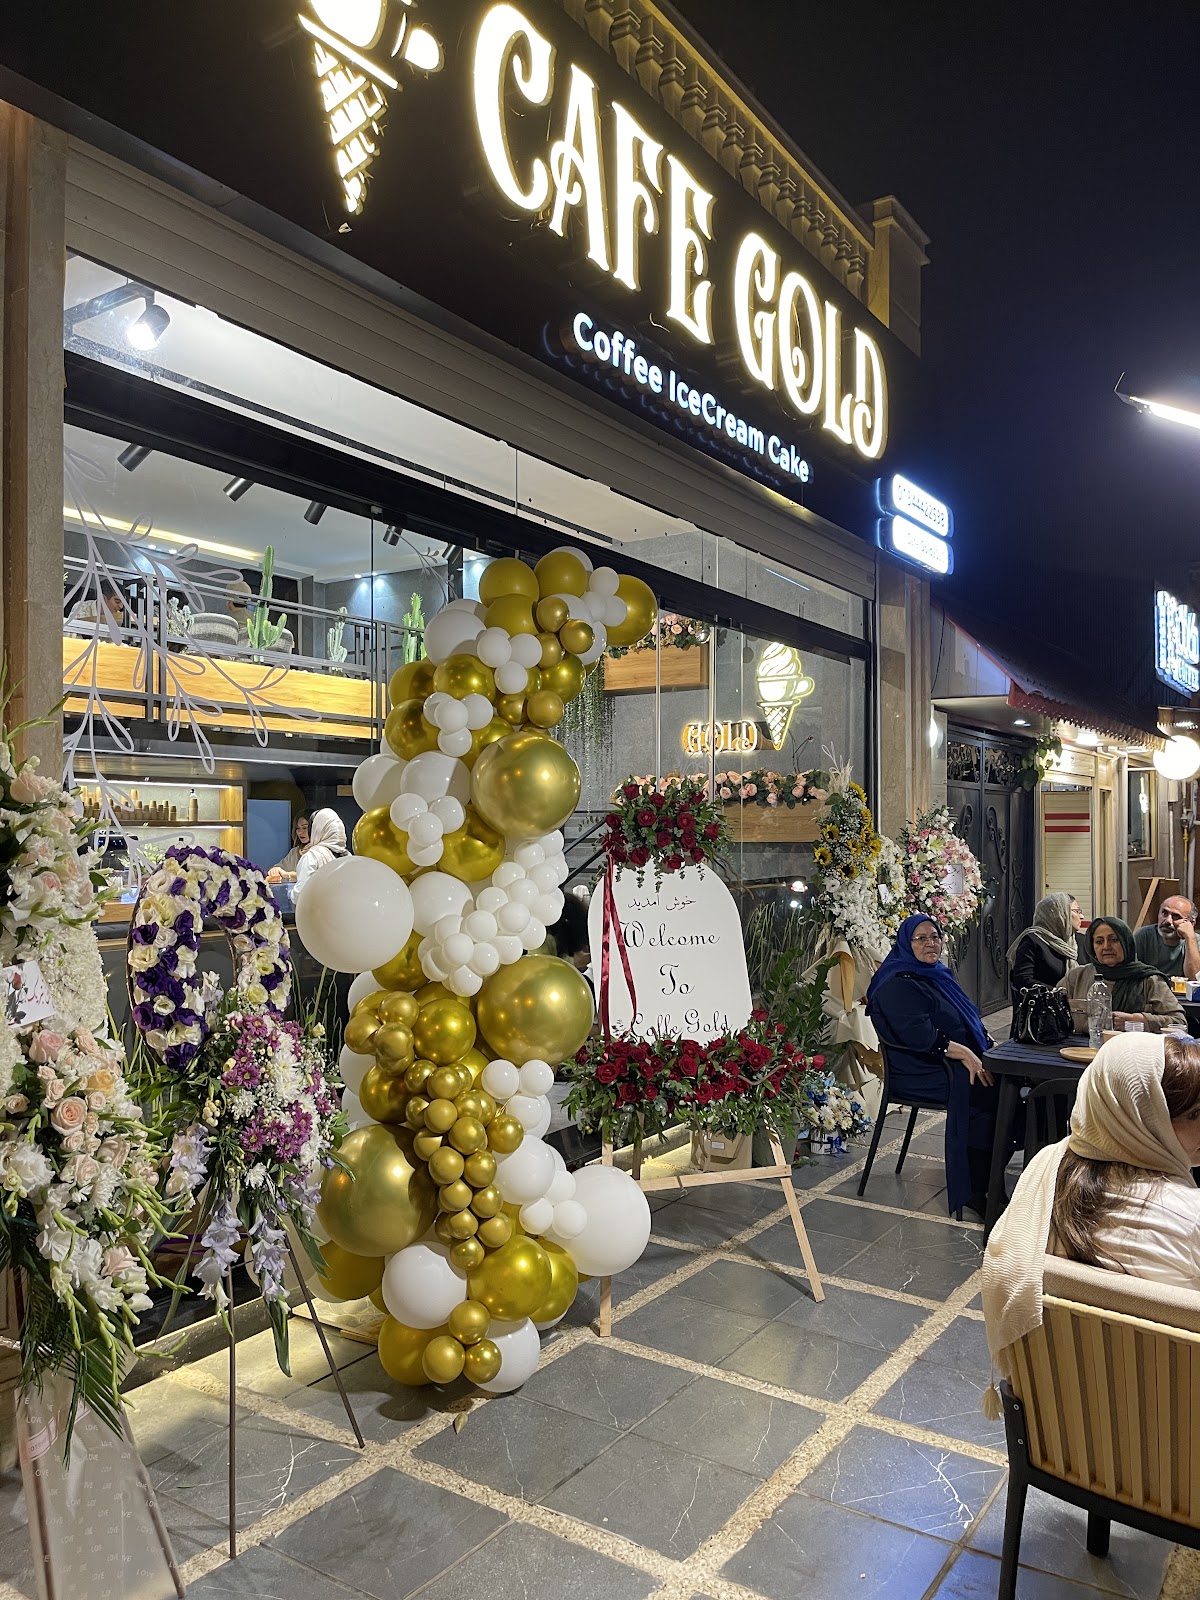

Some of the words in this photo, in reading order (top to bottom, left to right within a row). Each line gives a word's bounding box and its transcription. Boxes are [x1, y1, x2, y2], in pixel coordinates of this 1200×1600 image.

[474, 4, 715, 345] CAFE
[735, 232, 886, 460] GOLD
[573, 312, 663, 394] Coffee
[669, 369, 765, 455] IceCream
[768, 434, 810, 483] Cake
[684, 719, 758, 754] GOLD
[666, 895, 697, 911] خوش
[619, 920, 721, 948] Welcome
[659, 963, 696, 996] To
[684, 1008, 733, 1034] Gold
[26, 1416, 42, 1424] LOVE
[35, 1469, 49, 1477] OVE
